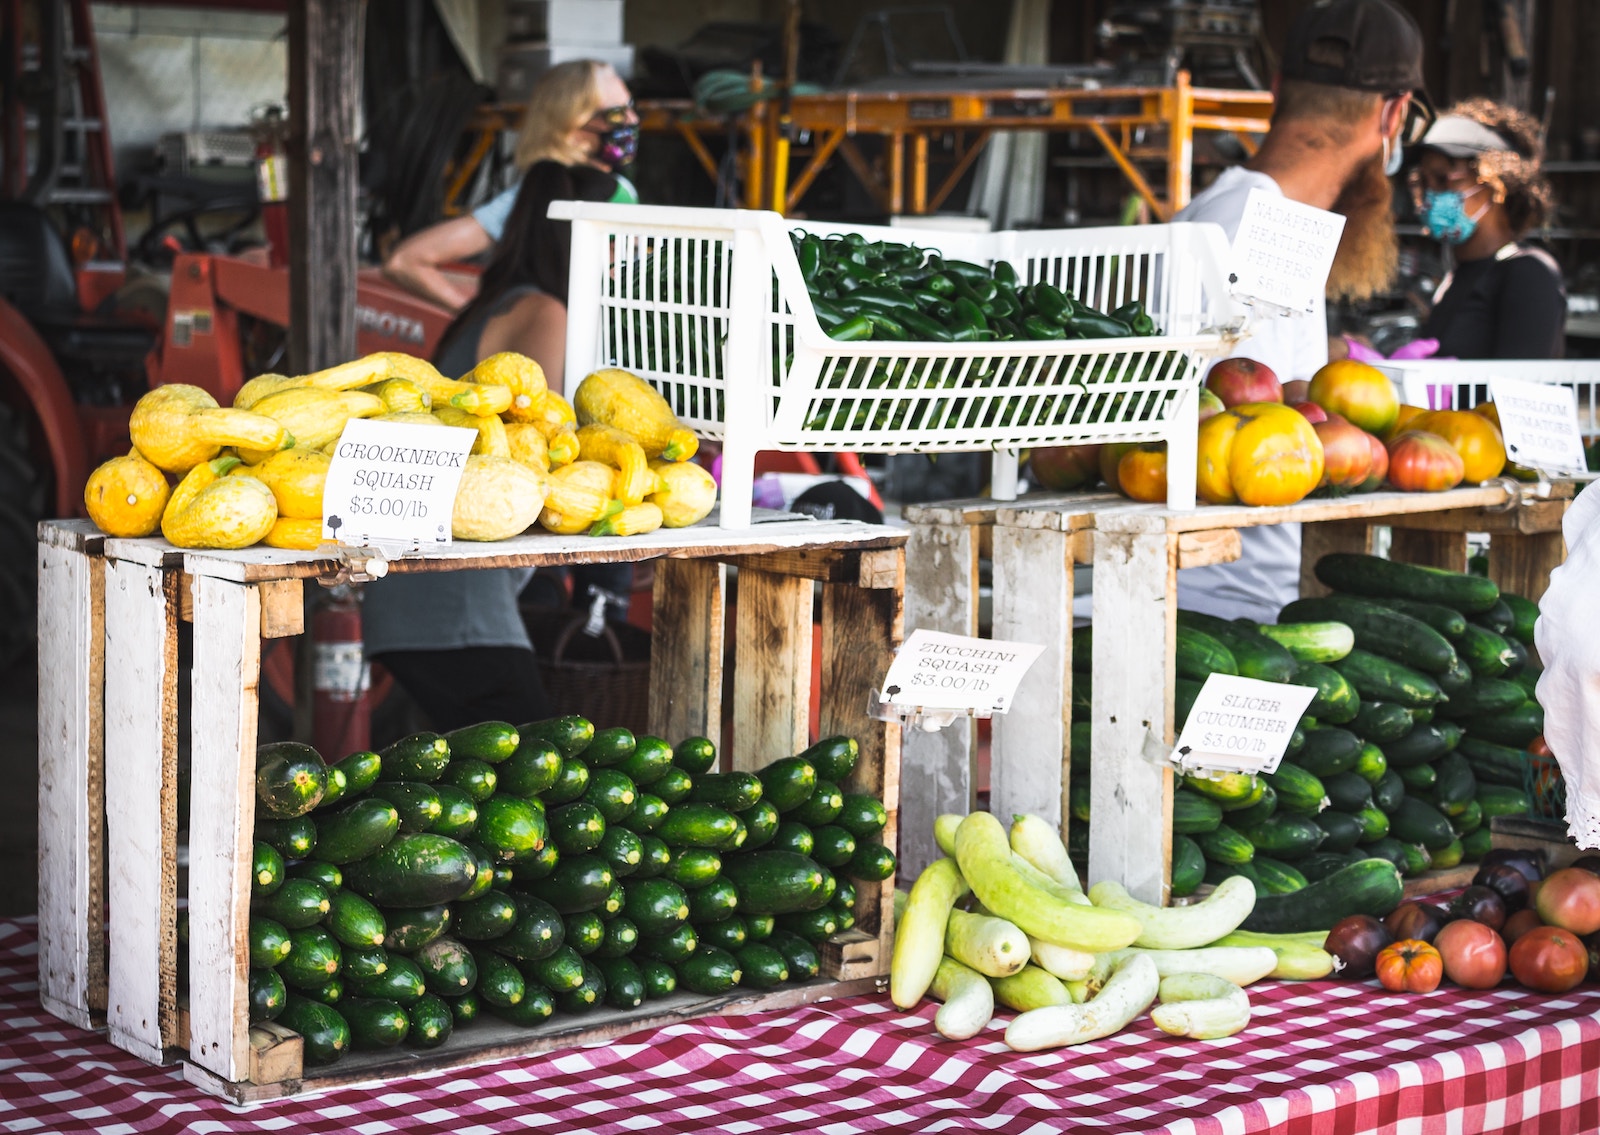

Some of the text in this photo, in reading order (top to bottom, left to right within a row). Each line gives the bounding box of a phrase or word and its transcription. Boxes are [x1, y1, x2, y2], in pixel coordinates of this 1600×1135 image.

[1248, 224, 1325, 260] HEATLESS
[1247, 248, 1313, 280] PEPPERS
[339, 442, 465, 468] CROOKNECK
[353, 469, 435, 491] SQUASH
[350, 494, 428, 520] $3.00/lb
[919, 642, 1019, 662] ZUCCHINI
[918, 657, 999, 675] SQUASH
[910, 672, 990, 694] $3.00/lb
[1221, 694, 1282, 713] SLICER
[1196, 711, 1288, 734] CUCUMBER
[1202, 731, 1267, 754] $3.00/lb
